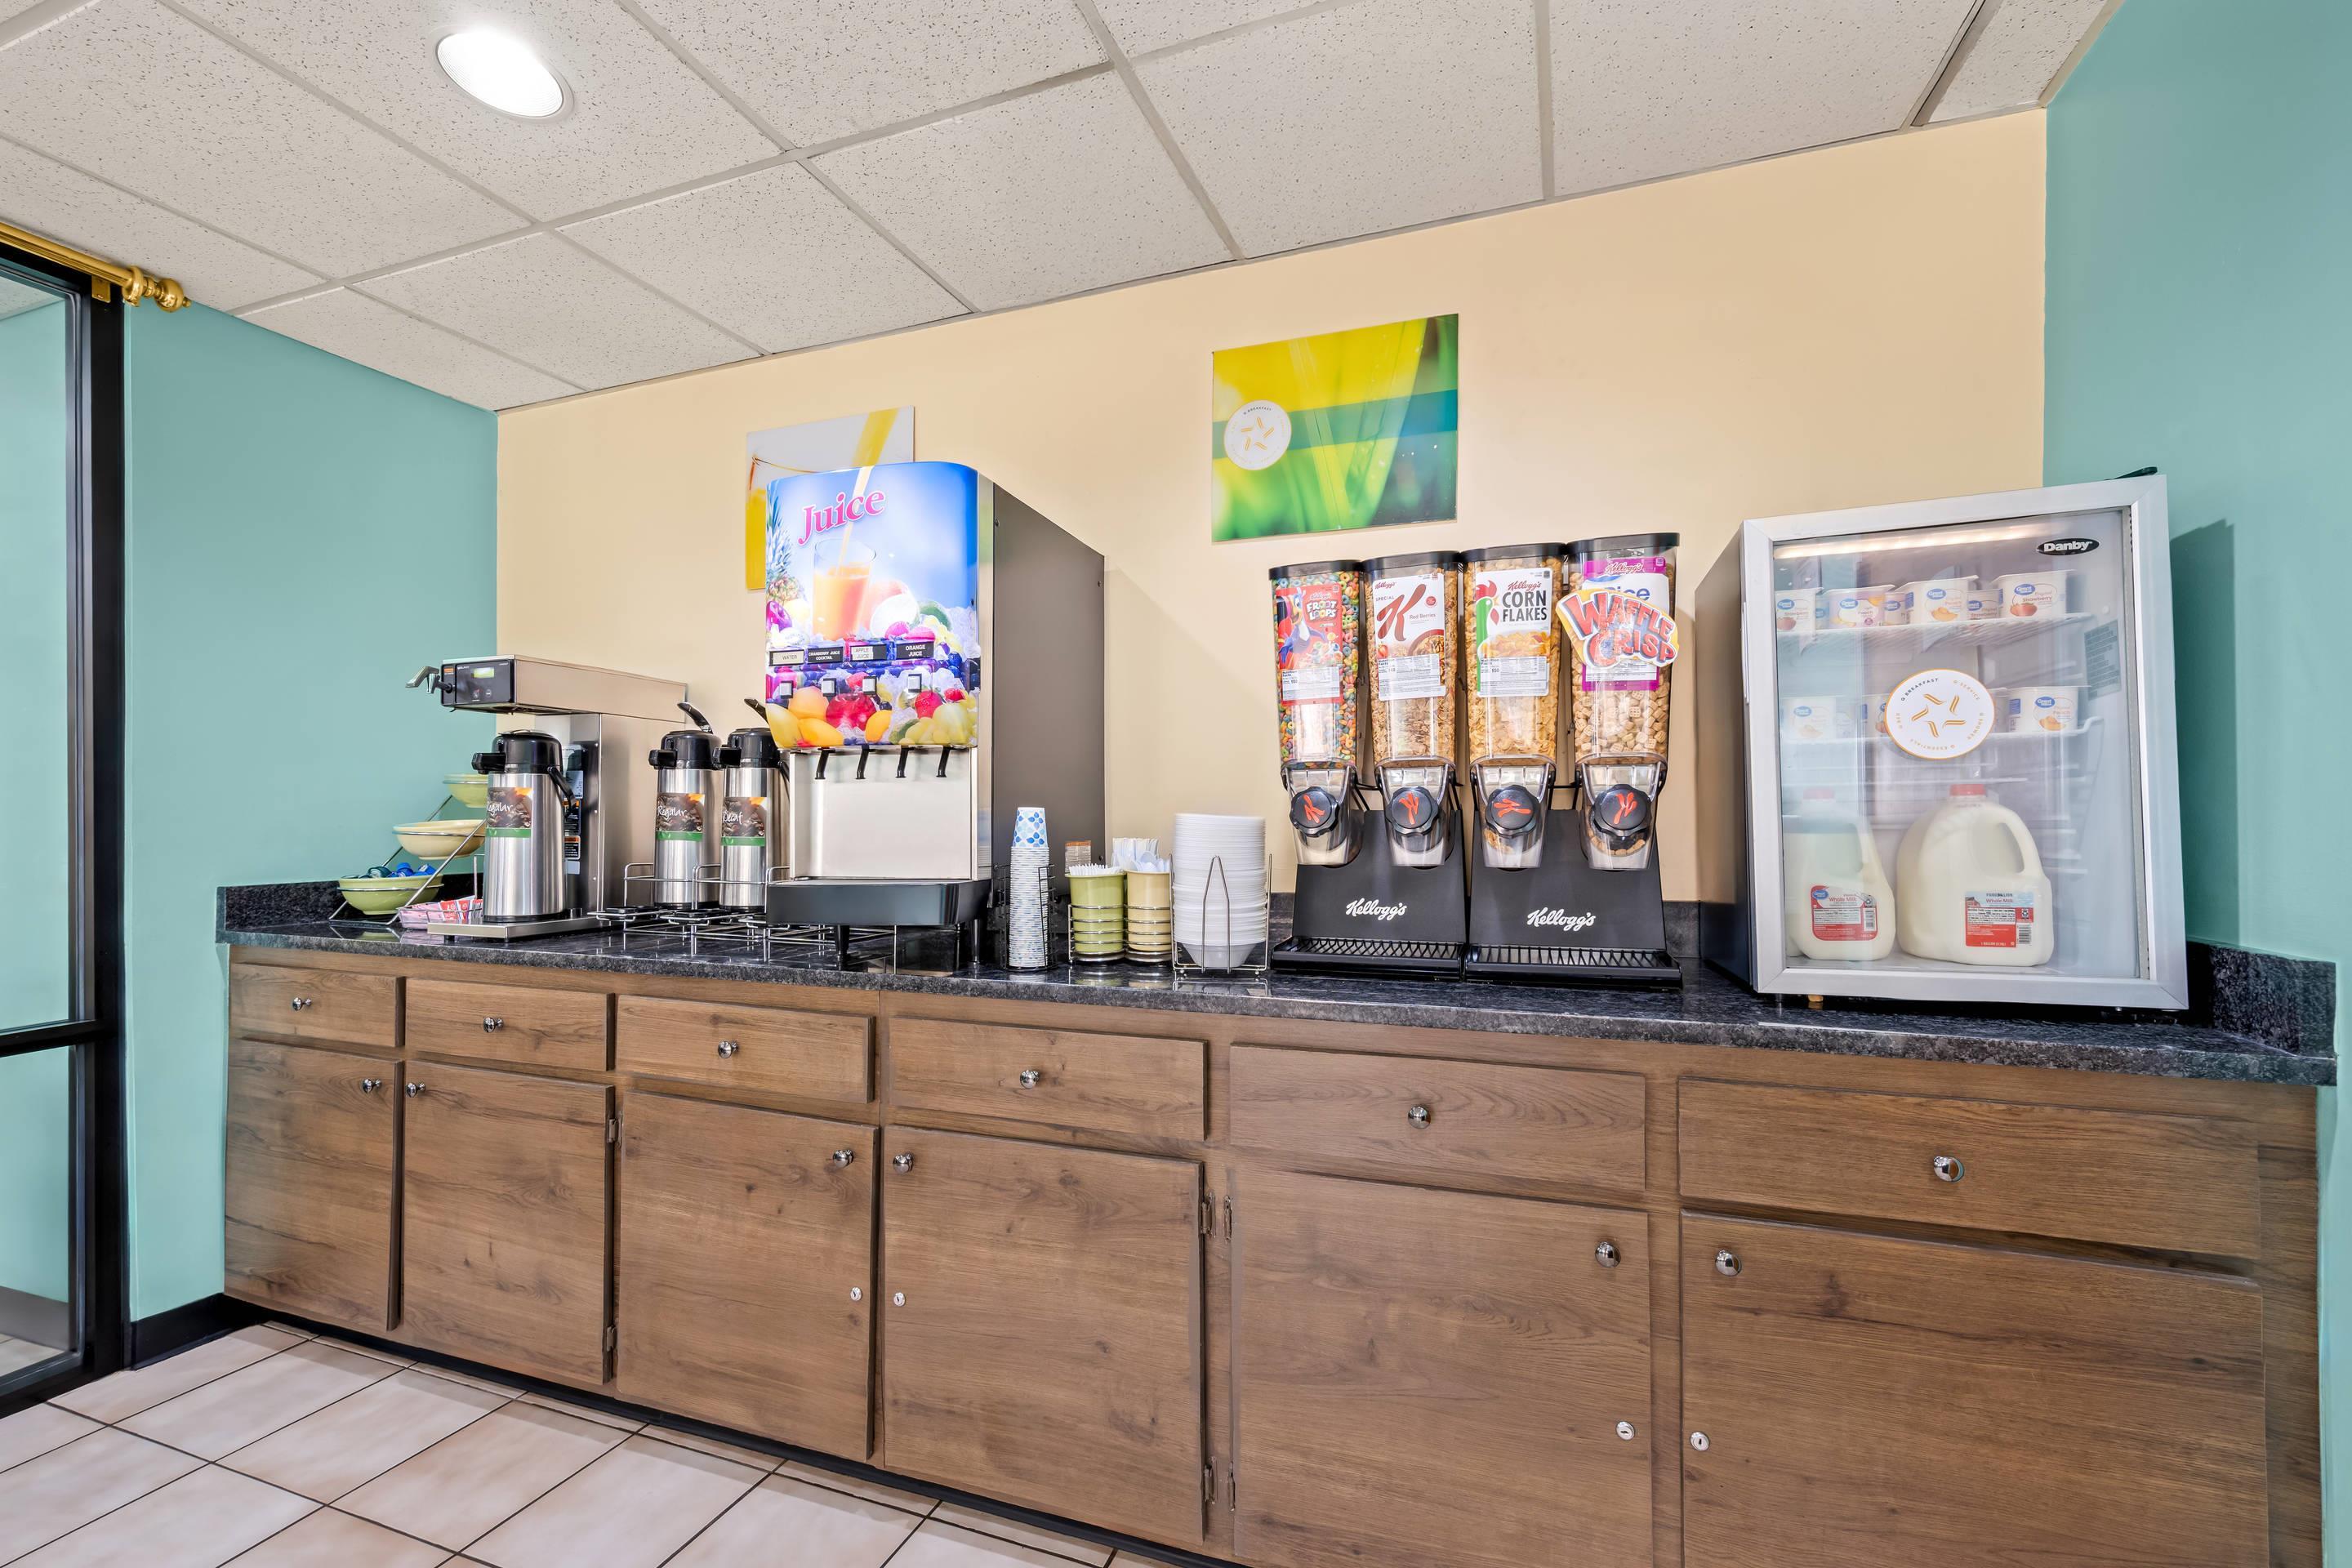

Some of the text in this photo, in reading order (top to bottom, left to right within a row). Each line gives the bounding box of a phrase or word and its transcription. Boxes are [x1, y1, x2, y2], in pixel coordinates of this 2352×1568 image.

[798, 490, 885, 546] Juice
[2043, 540, 2090, 552] Danby
[1605, 561, 1644, 574] Kellogg's
[1508, 580, 1542, 591] Kellogg's
[1306, 600, 1337, 612] FROOT
[1502, 590, 1547, 608] CORN
[1309, 608, 1337, 621] LOOPS
[1377, 583, 1427, 641] K
[1503, 607, 1548, 622] FLAKES
[1563, 591, 1674, 641] WAFFLE
[1588, 628, 1675, 667] CRISP
[1904, 678, 1939, 697] BREAKFAST
[657, 805, 688, 822] Regular
[722, 810, 743, 825] Decaf
[1346, 898, 1407, 920] Kellogg's
[1526, 906, 1596, 931] Kellogg's
